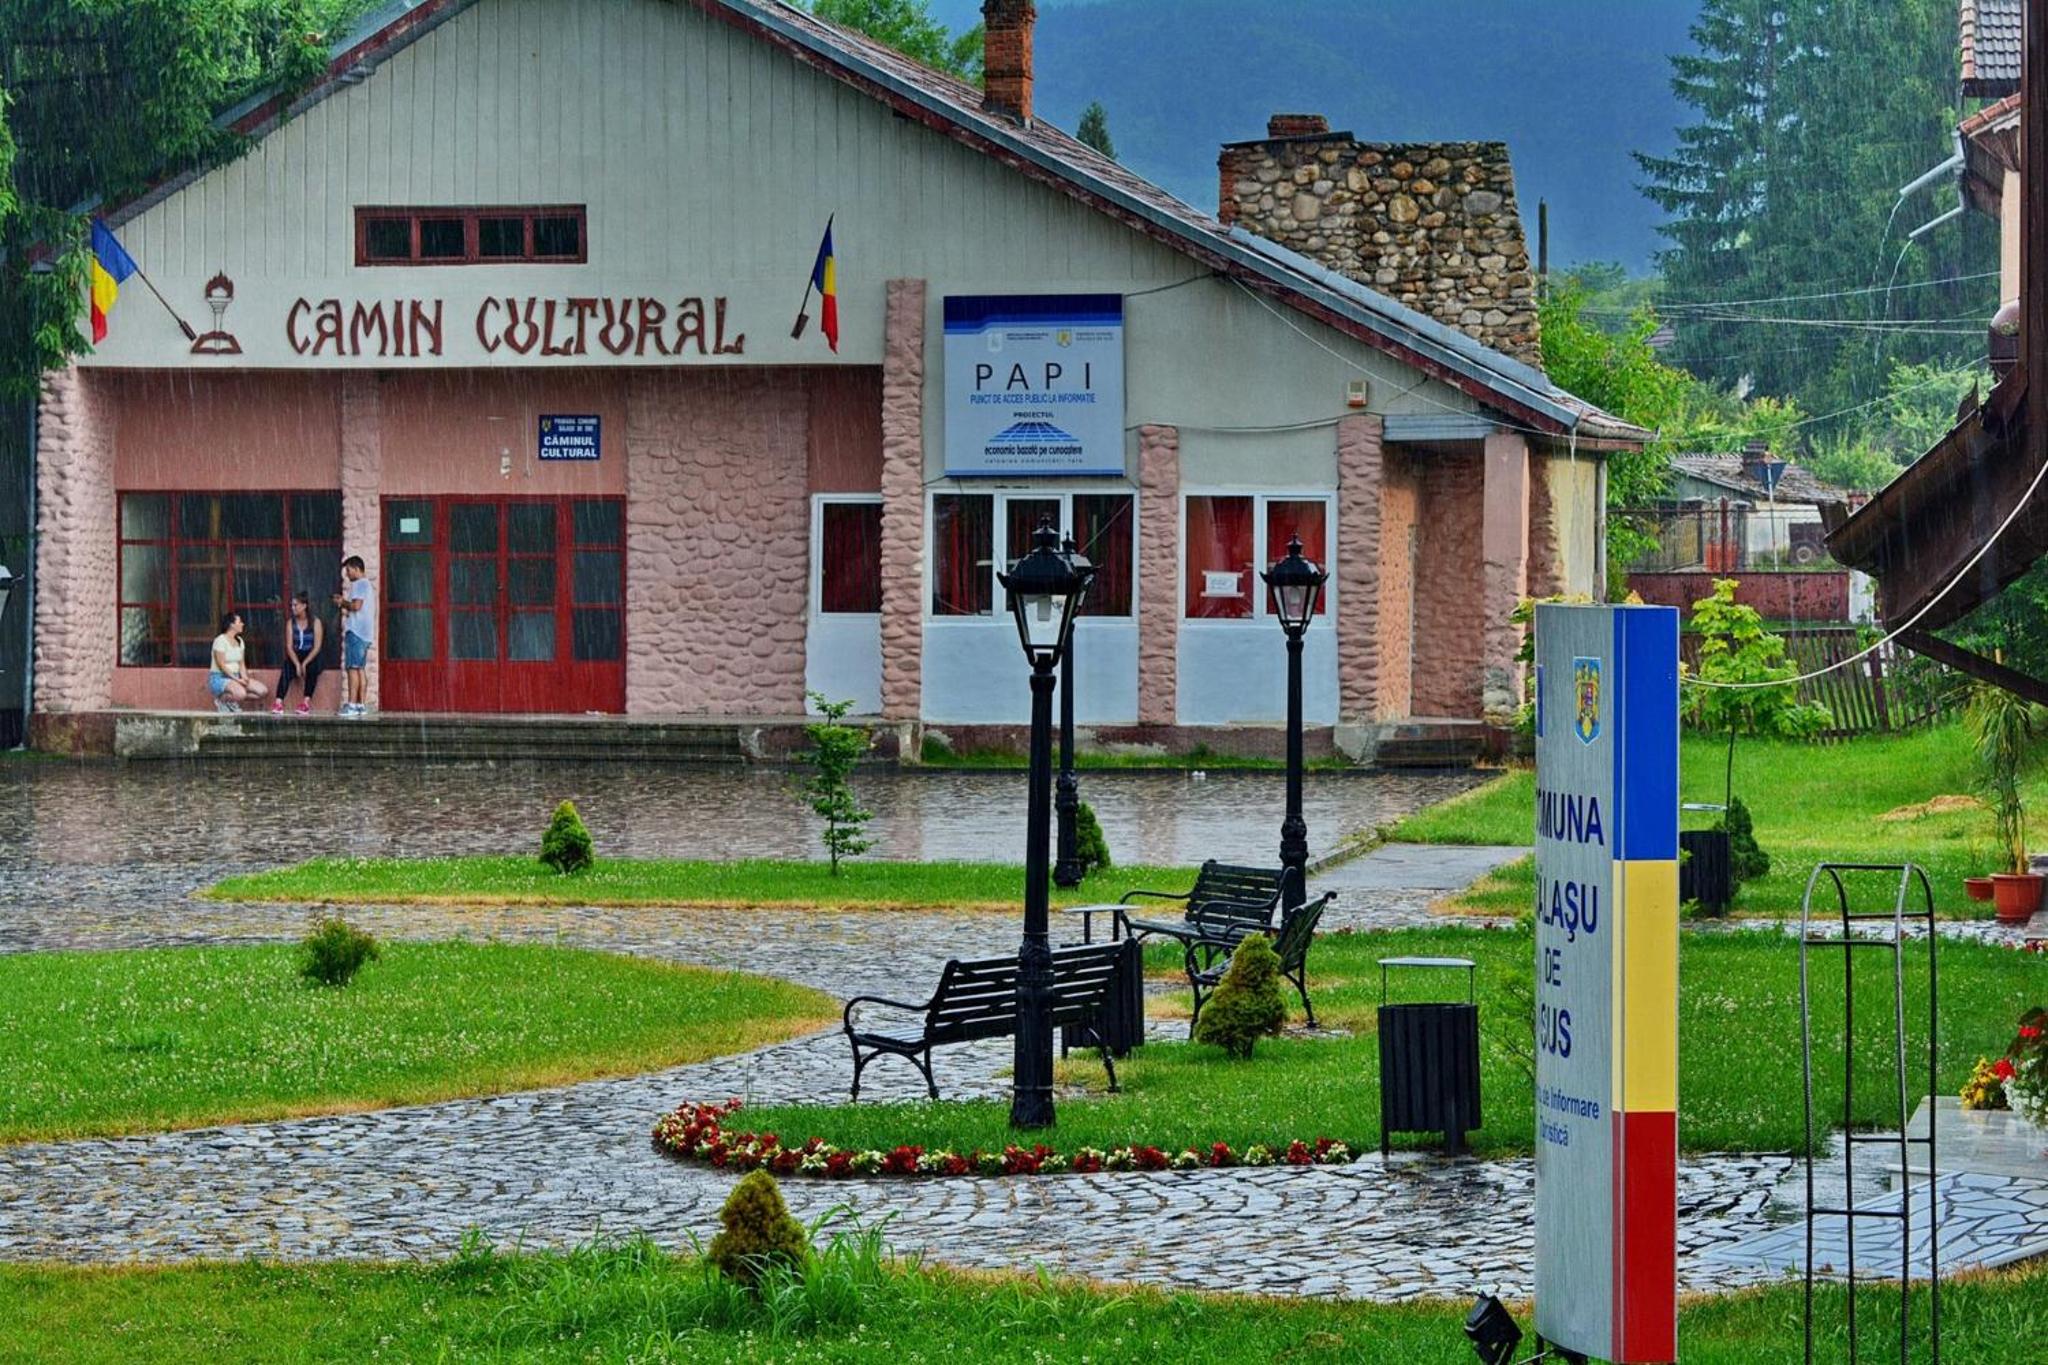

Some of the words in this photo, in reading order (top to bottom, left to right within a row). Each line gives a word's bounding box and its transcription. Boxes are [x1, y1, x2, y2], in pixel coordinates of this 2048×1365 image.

[286, 296, 443, 357] CAMIN
[476, 296, 745, 356] CULTURAL
[975, 362, 1091, 391] PAPI
[992, 394, 1002, 404] DE
[541, 447, 598, 458] CULTURAL
[1536, 788, 1604, 846] MUNA
[1545, 947, 1561, 986] DE
[1541, 1003, 1571, 1058] SUS
[1551, 1086, 1600, 1119] Informare
